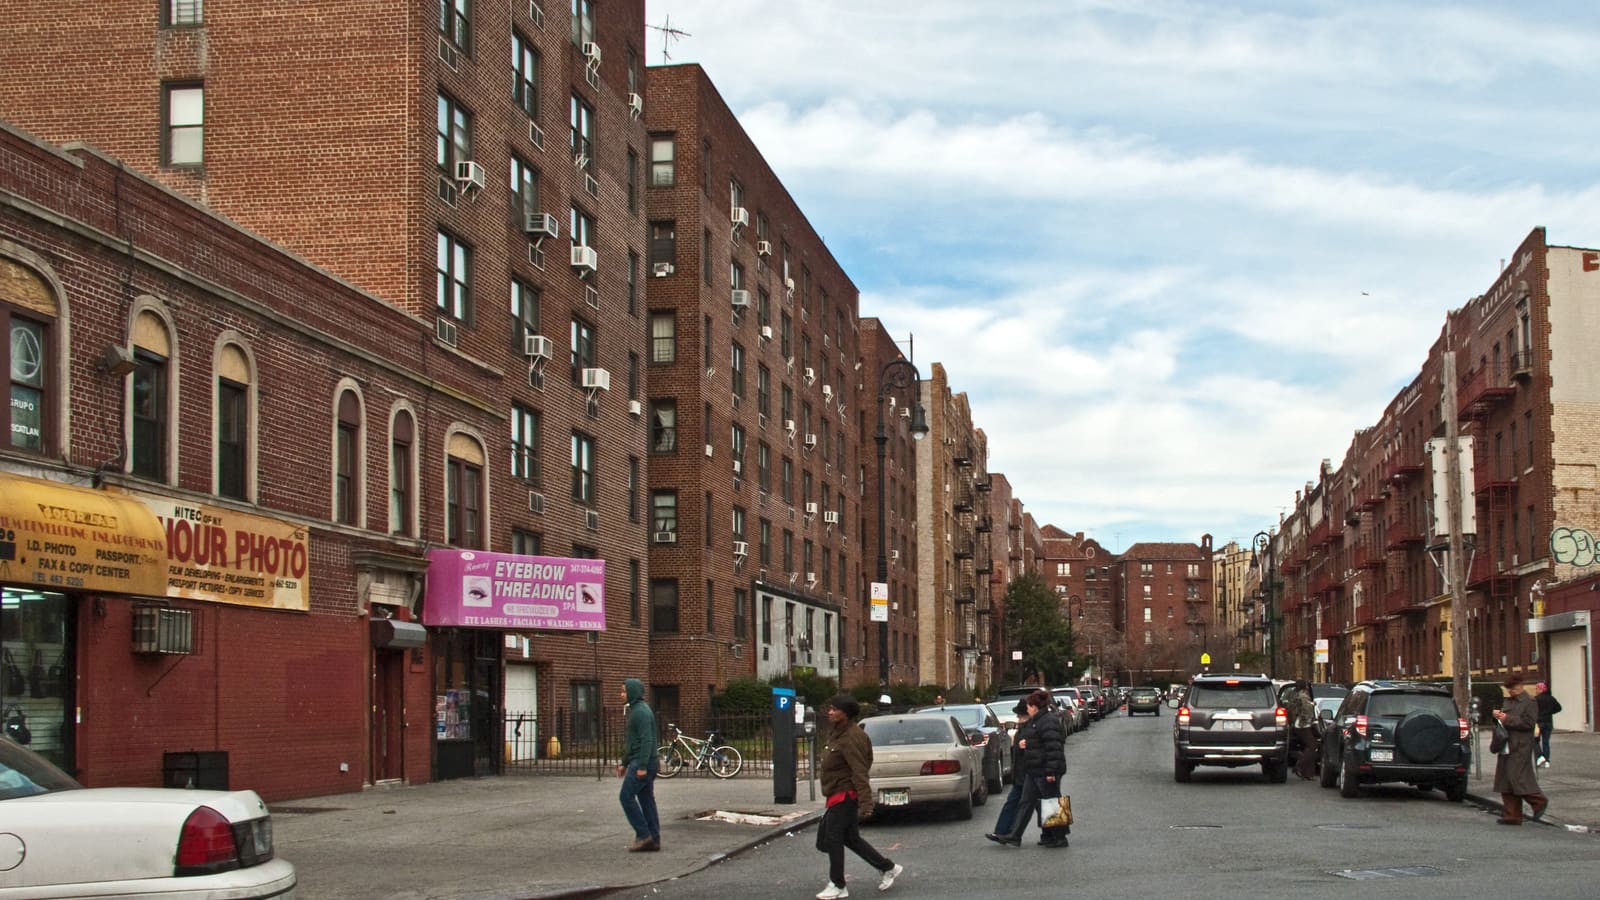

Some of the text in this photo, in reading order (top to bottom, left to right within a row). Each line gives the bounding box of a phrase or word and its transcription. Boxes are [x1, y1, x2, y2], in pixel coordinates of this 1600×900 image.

[175, 506, 202, 521] HITEC
[27, 540, 42, 552] I.D.
[44, 542, 77, 556] PHOTO
[235, 531, 307, 579] PHOTO
[39, 558, 130, 580] FAX & COPY CENTER
[168, 565, 183, 576] FILM
[184, 567, 221, 580] DEVELOPING
[225, 573, 265, 587] ENLARGEMENTS
[495, 560, 566, 581] EYEBROW
[167, 578, 197, 590] PASSPORT
[199, 581, 225, 593] PICTURES
[228, 586, 243, 596] COPY
[494, 580, 575, 601] THREADING
[562, 602, 576, 611] SPA
[464, 616, 479, 625] EYE
[480, 616, 507, 626] LASHES
[512, 618, 542, 627] FACIALS
[546, 619, 574, 628] WAXING
[780, 697, 788, 709] P
